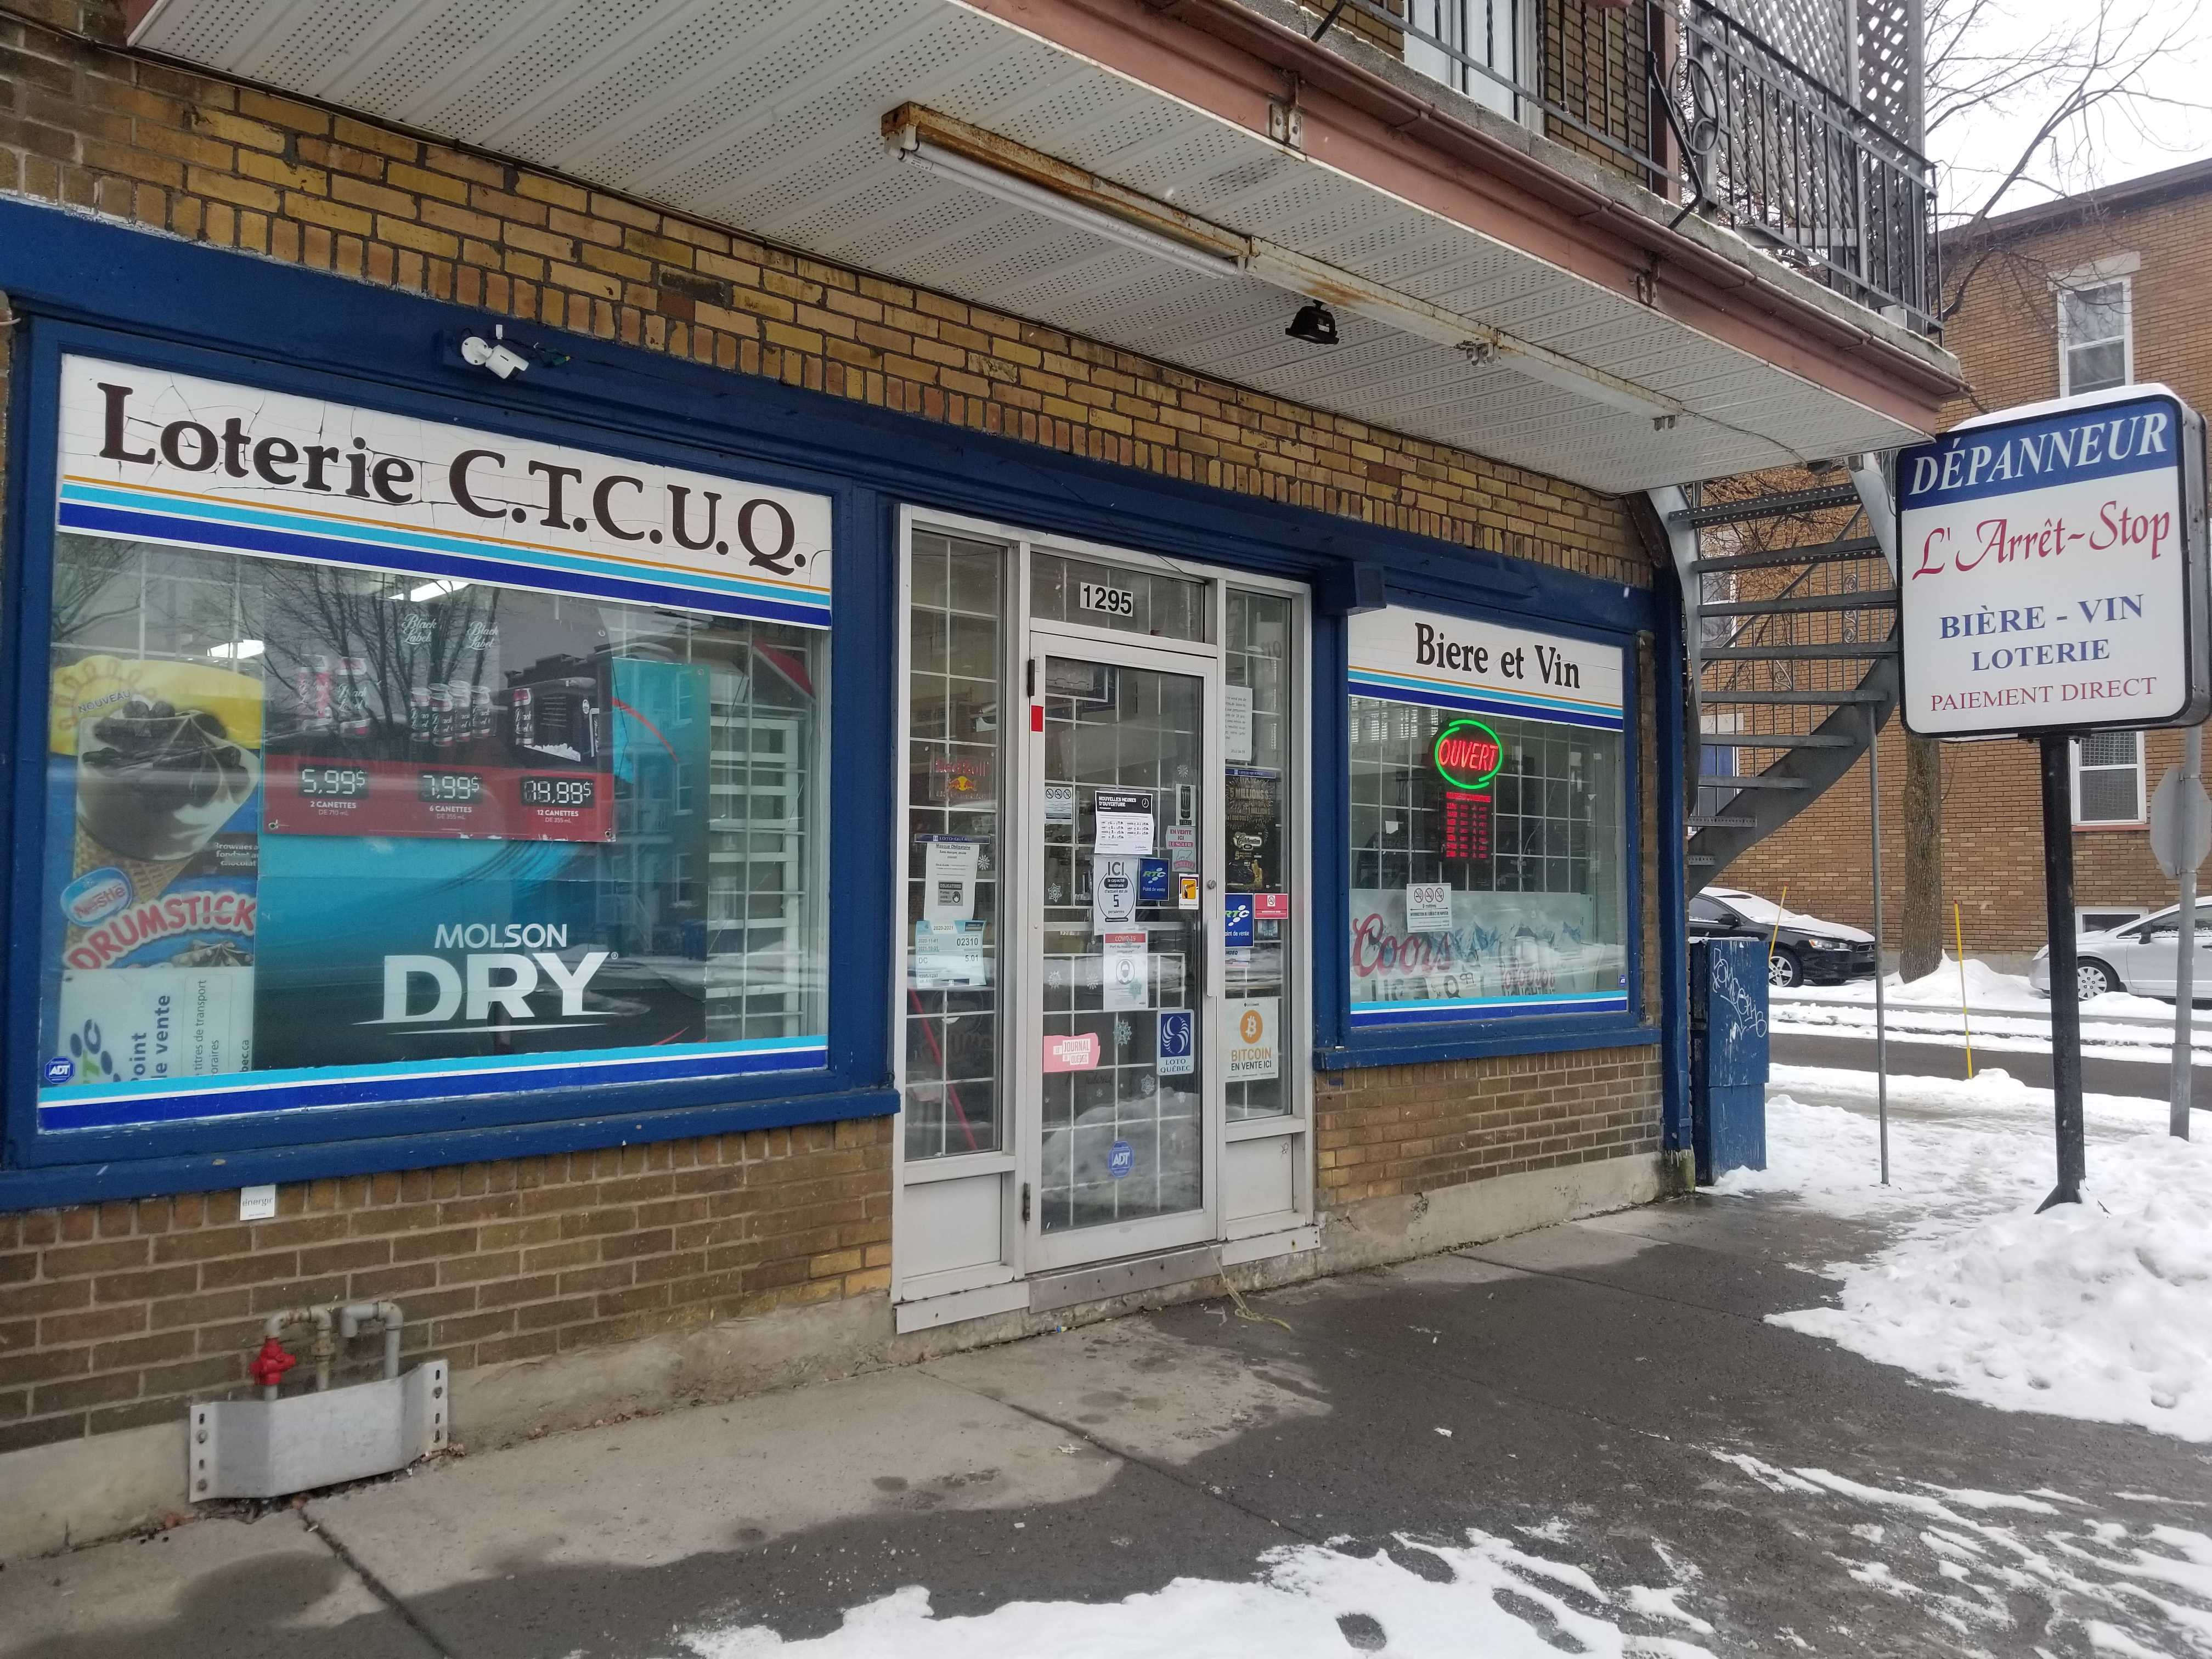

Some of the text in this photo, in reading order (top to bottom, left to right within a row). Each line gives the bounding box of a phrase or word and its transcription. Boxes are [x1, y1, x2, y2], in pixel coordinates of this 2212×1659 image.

[1909, 413, 2168, 496] DÉPANNEUR
[97, 382, 806, 575] Loterie C.T.C.U.Q.
[1083, 585, 1133, 614] 1295
[402, 613, 437, 630] Black
[1939, 606, 2045, 639] BIÈRE
[2077, 595, 2144, 624] VIN
[403, 628, 432, 645] Label
[466, 622, 499, 635] Black
[467, 635, 494, 651] Label
[1415, 623, 1580, 689] Biere et Vin
[1971, 639, 2110, 672] LOTERIE
[78, 689, 132, 714] NOUVEAU
[1931, 677, 2157, 712] PAIEMENT DIRECT
[1438, 739, 1498, 771] OUVERT
[1235, 788, 1264, 799] MILLIONS
[317, 801, 357, 809] CANETTES
[1108, 861, 1124, 876] ICI
[1113, 894, 1120, 907] 5
[67, 895, 256, 970] DRUMSTICK
[434, 923, 567, 949] MOLSON
[957, 938, 978, 946] 02310
[1352, 913, 1451, 977] Coors
[155, 995, 171, 1058] vente
[194, 979, 209, 1070] titres de transport
[1063, 1040, 1089, 1052] JOURNAL
[1231, 1047, 1272, 1062] BITCOIN
[48, 1064, 71, 1076] ADT
[1160, 1065, 1190, 1073] QUÉBEC
[1231, 1060, 1272, 1071] EN VENTE ICI
[1112, 1152, 1130, 1166] ADT
